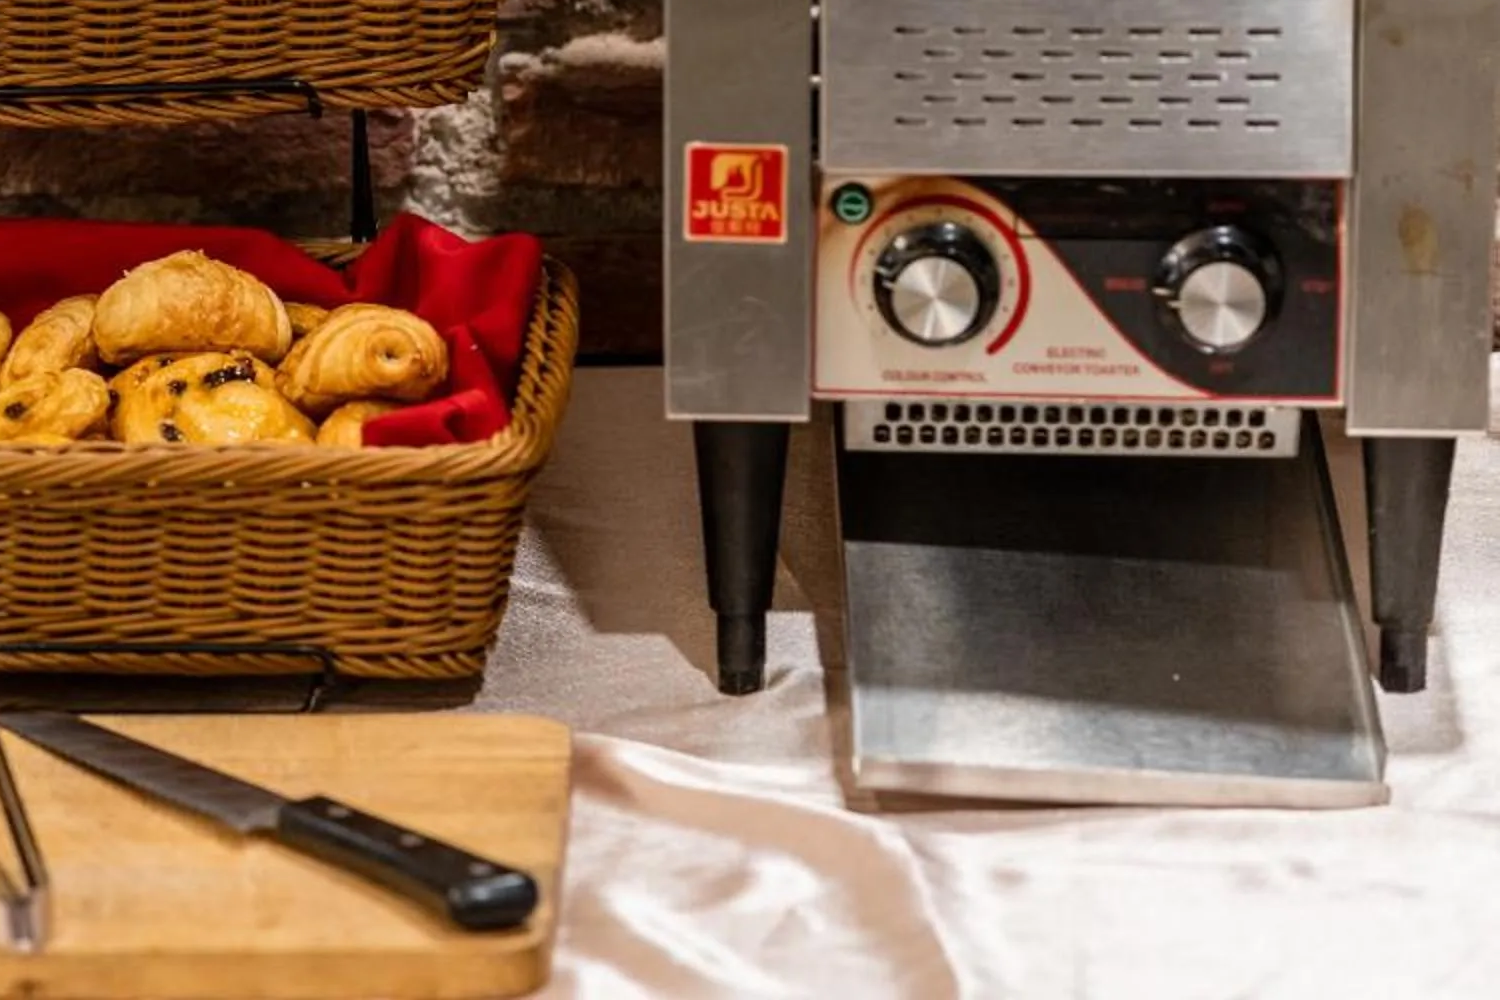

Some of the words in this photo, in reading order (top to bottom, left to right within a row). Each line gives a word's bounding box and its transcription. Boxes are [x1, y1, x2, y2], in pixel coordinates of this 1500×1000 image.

[692, 200, 778, 220] JUSTA
[1012, 362, 1082, 376] CONVEYOR
[1084, 363, 1141, 377] TOASTER
